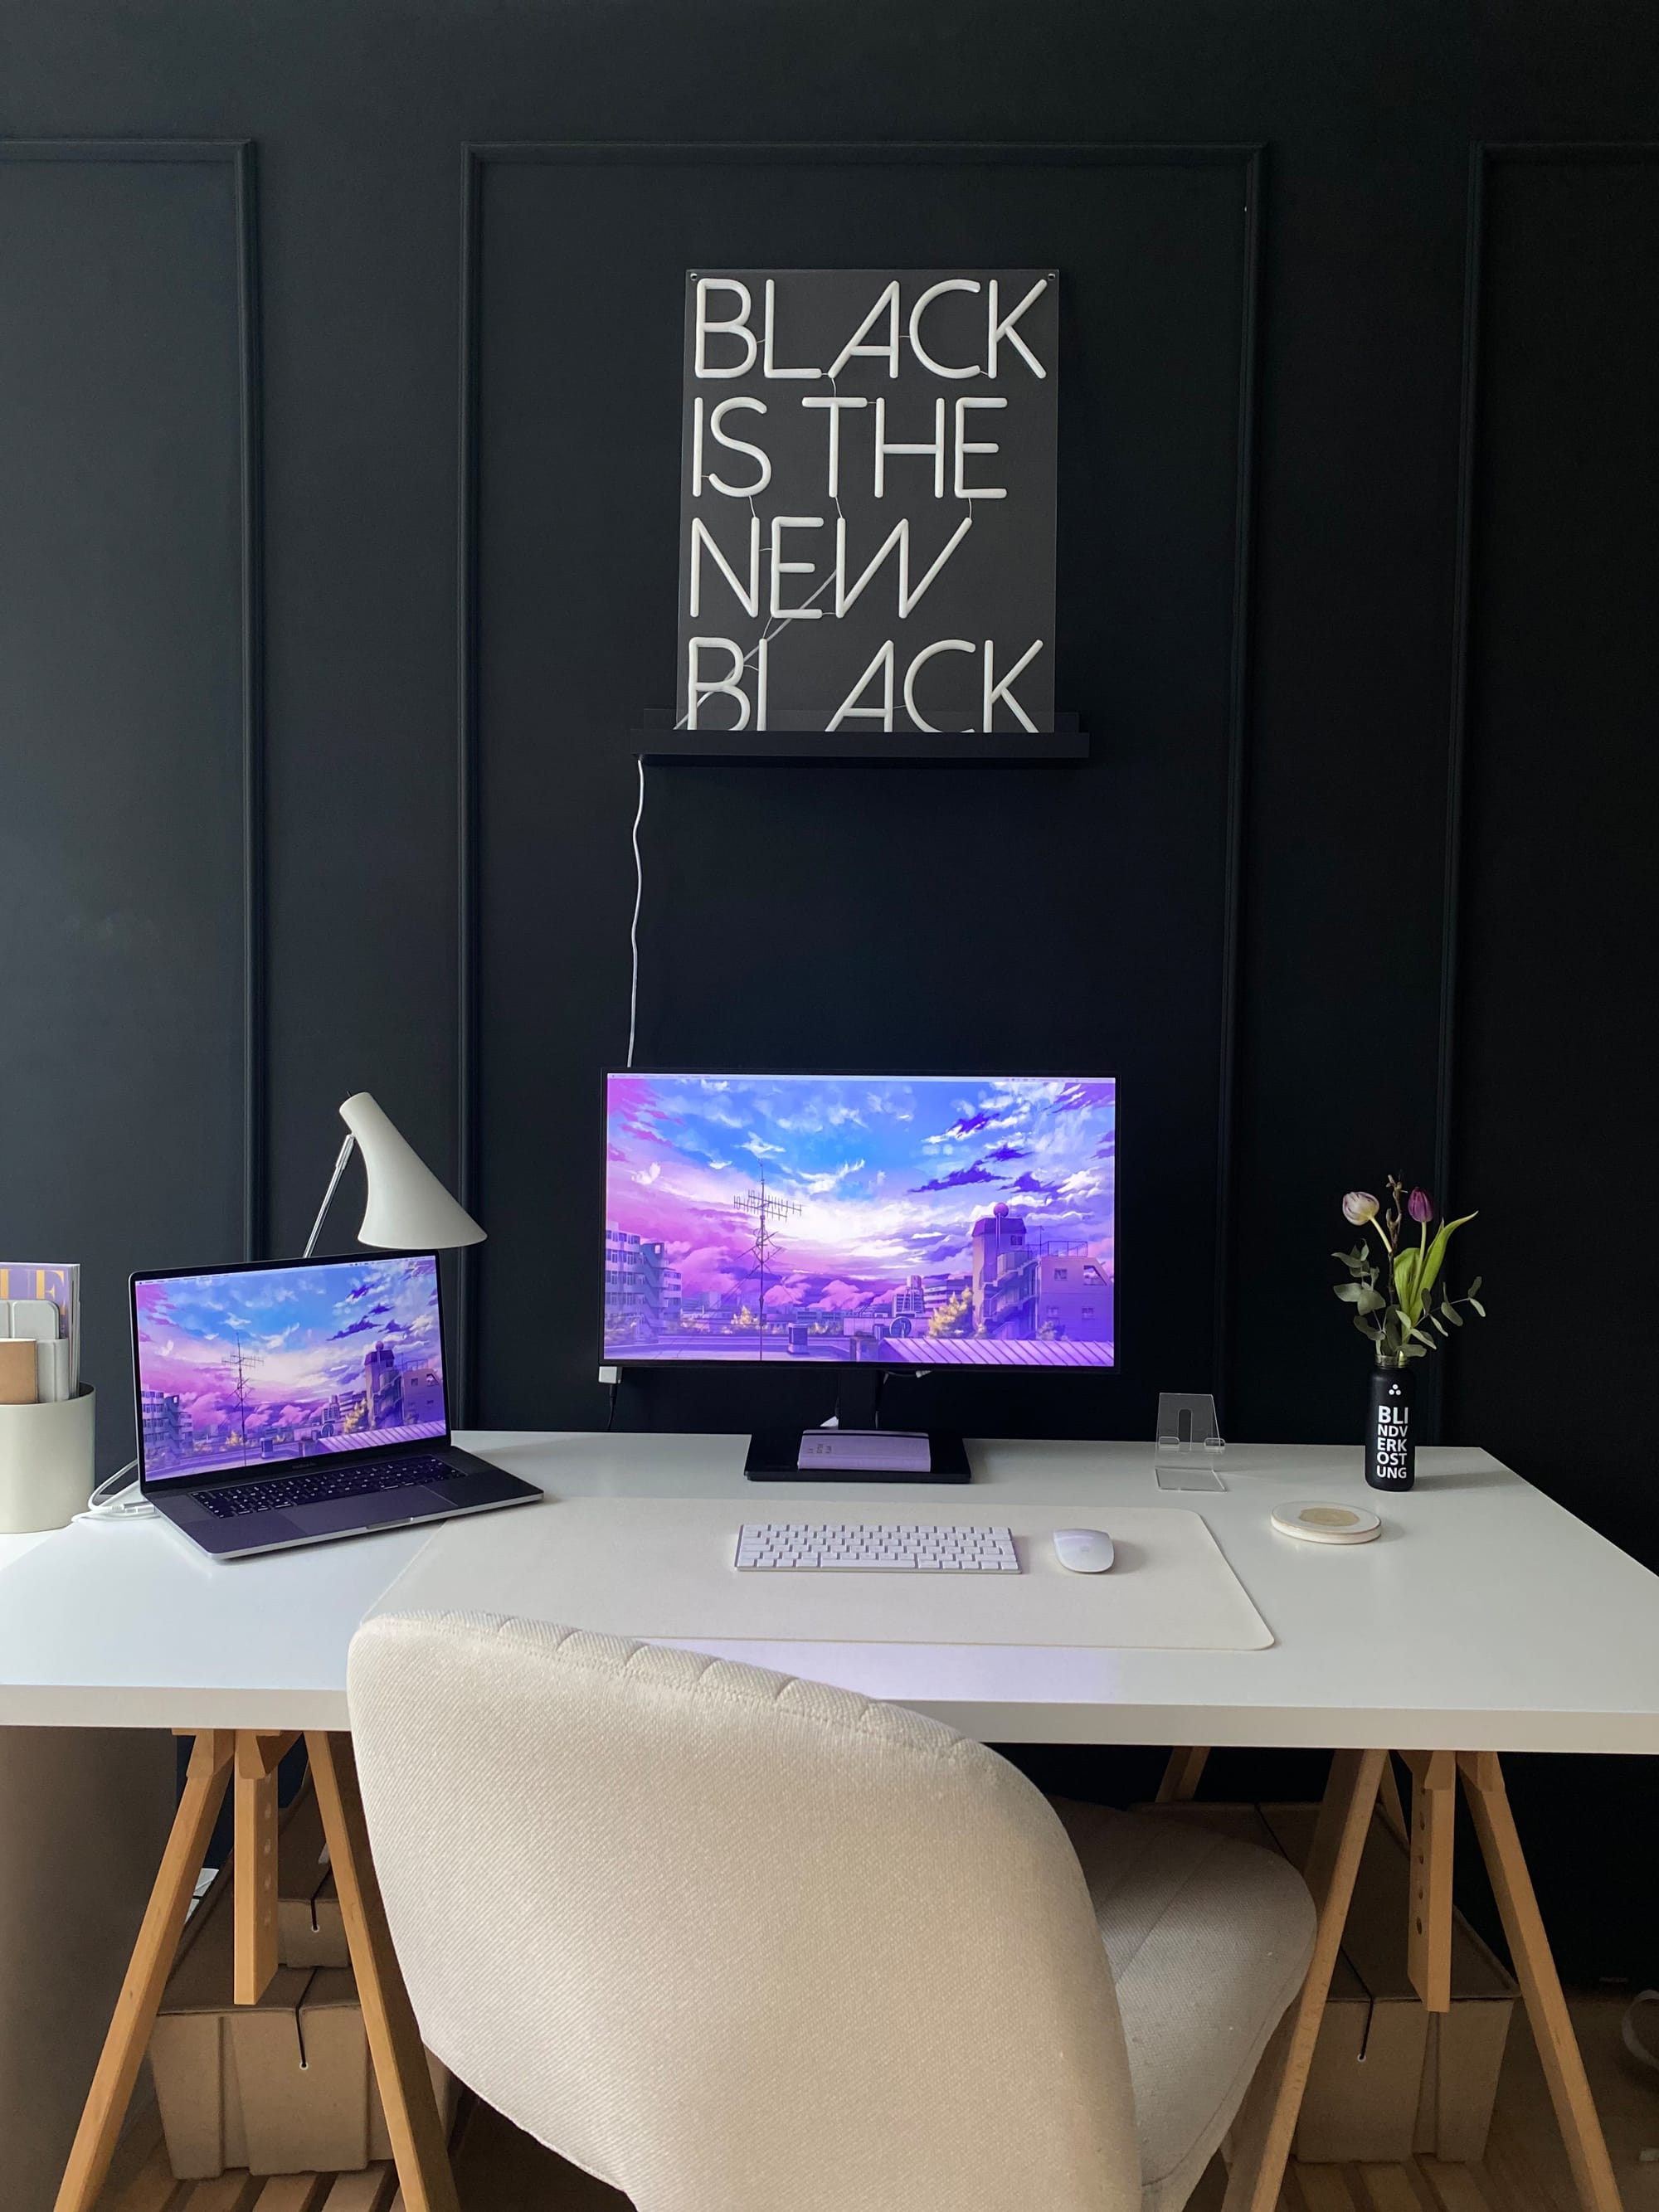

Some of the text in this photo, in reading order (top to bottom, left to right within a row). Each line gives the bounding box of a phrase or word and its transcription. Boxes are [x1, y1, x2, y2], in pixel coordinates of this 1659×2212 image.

[694, 278, 1048, 379] BLACK
[692, 396, 1008, 499] IS THE
[690, 516, 972, 619] NEW
[1378, 1405, 1408, 1424] BLI
[1377, 1424, 1408, 1437] NDV
[1377, 1437, 1408, 1451] ERK
[1376, 1451, 1408, 1466] OST
[1376, 1465, 1407, 1479] UNG
